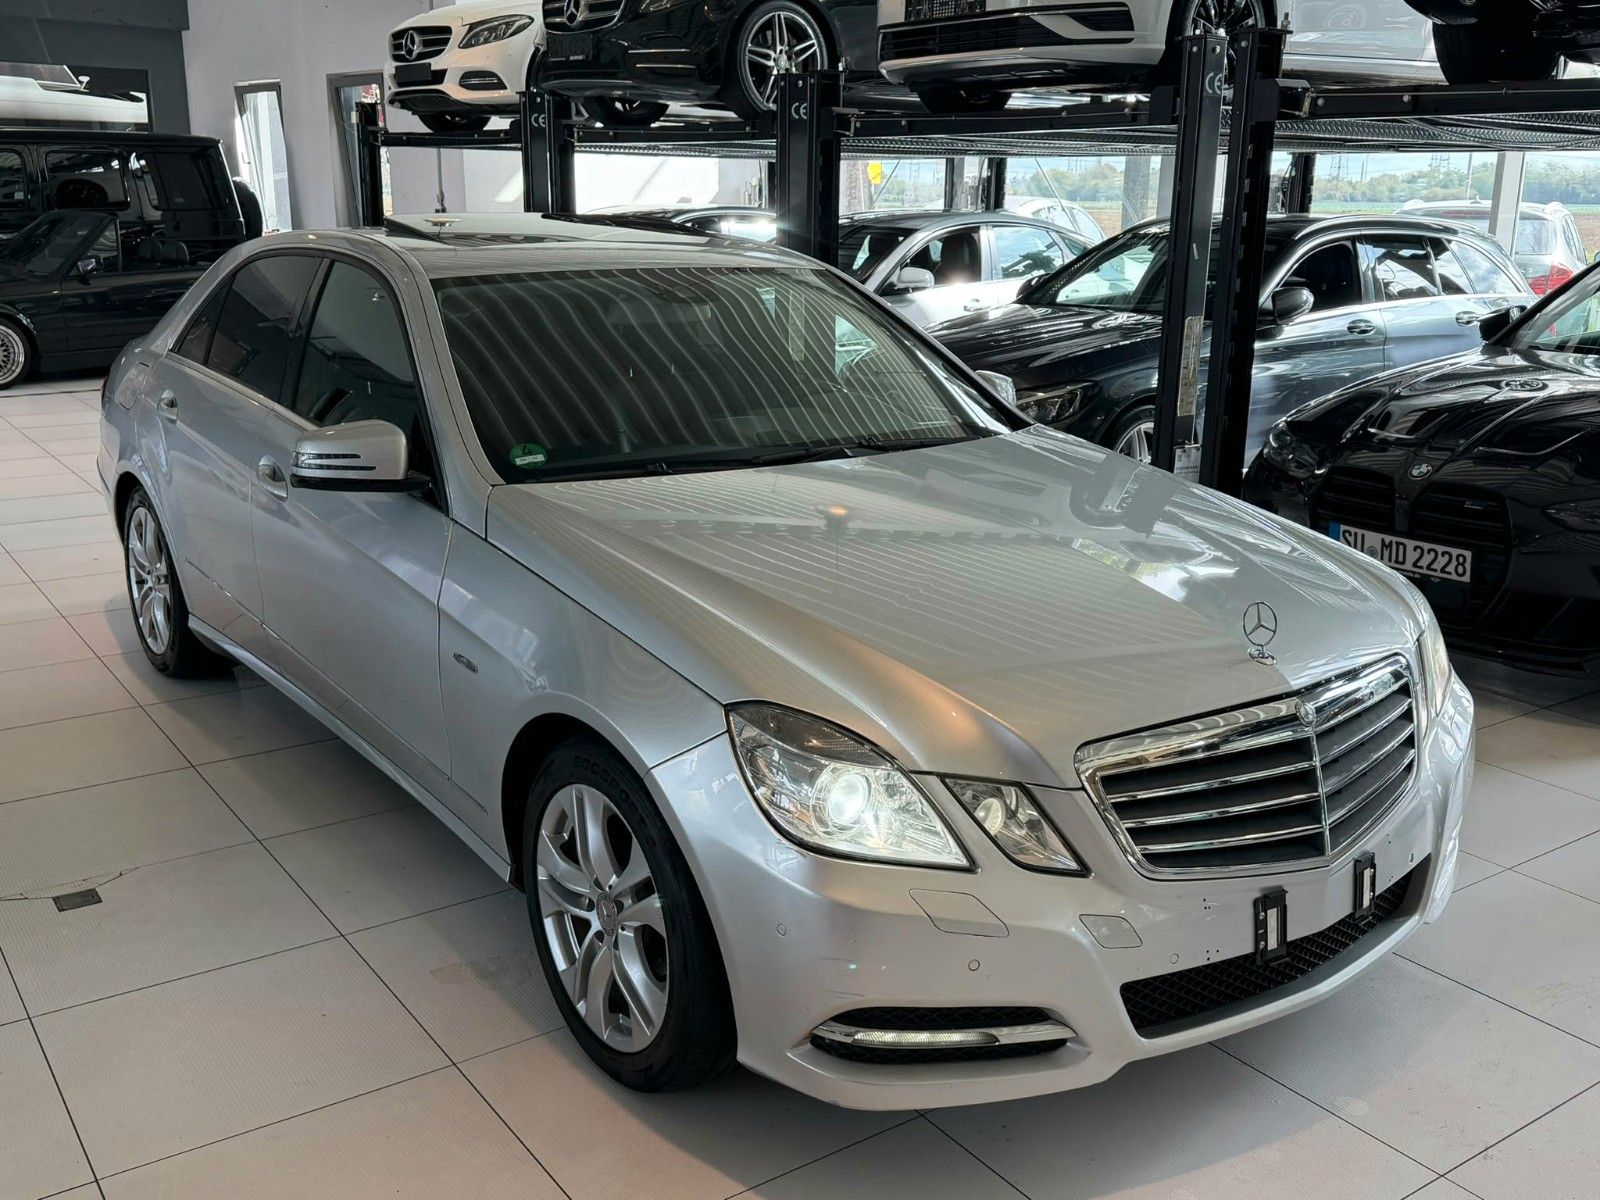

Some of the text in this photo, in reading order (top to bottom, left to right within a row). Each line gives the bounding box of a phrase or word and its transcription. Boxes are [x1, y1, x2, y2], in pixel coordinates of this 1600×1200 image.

[1205, 72, 1223, 95] CE
[531, 113, 546, 128] CE
[791, 102, 808, 120] CE
[1342, 529, 1467, 577] SU MD 2228
